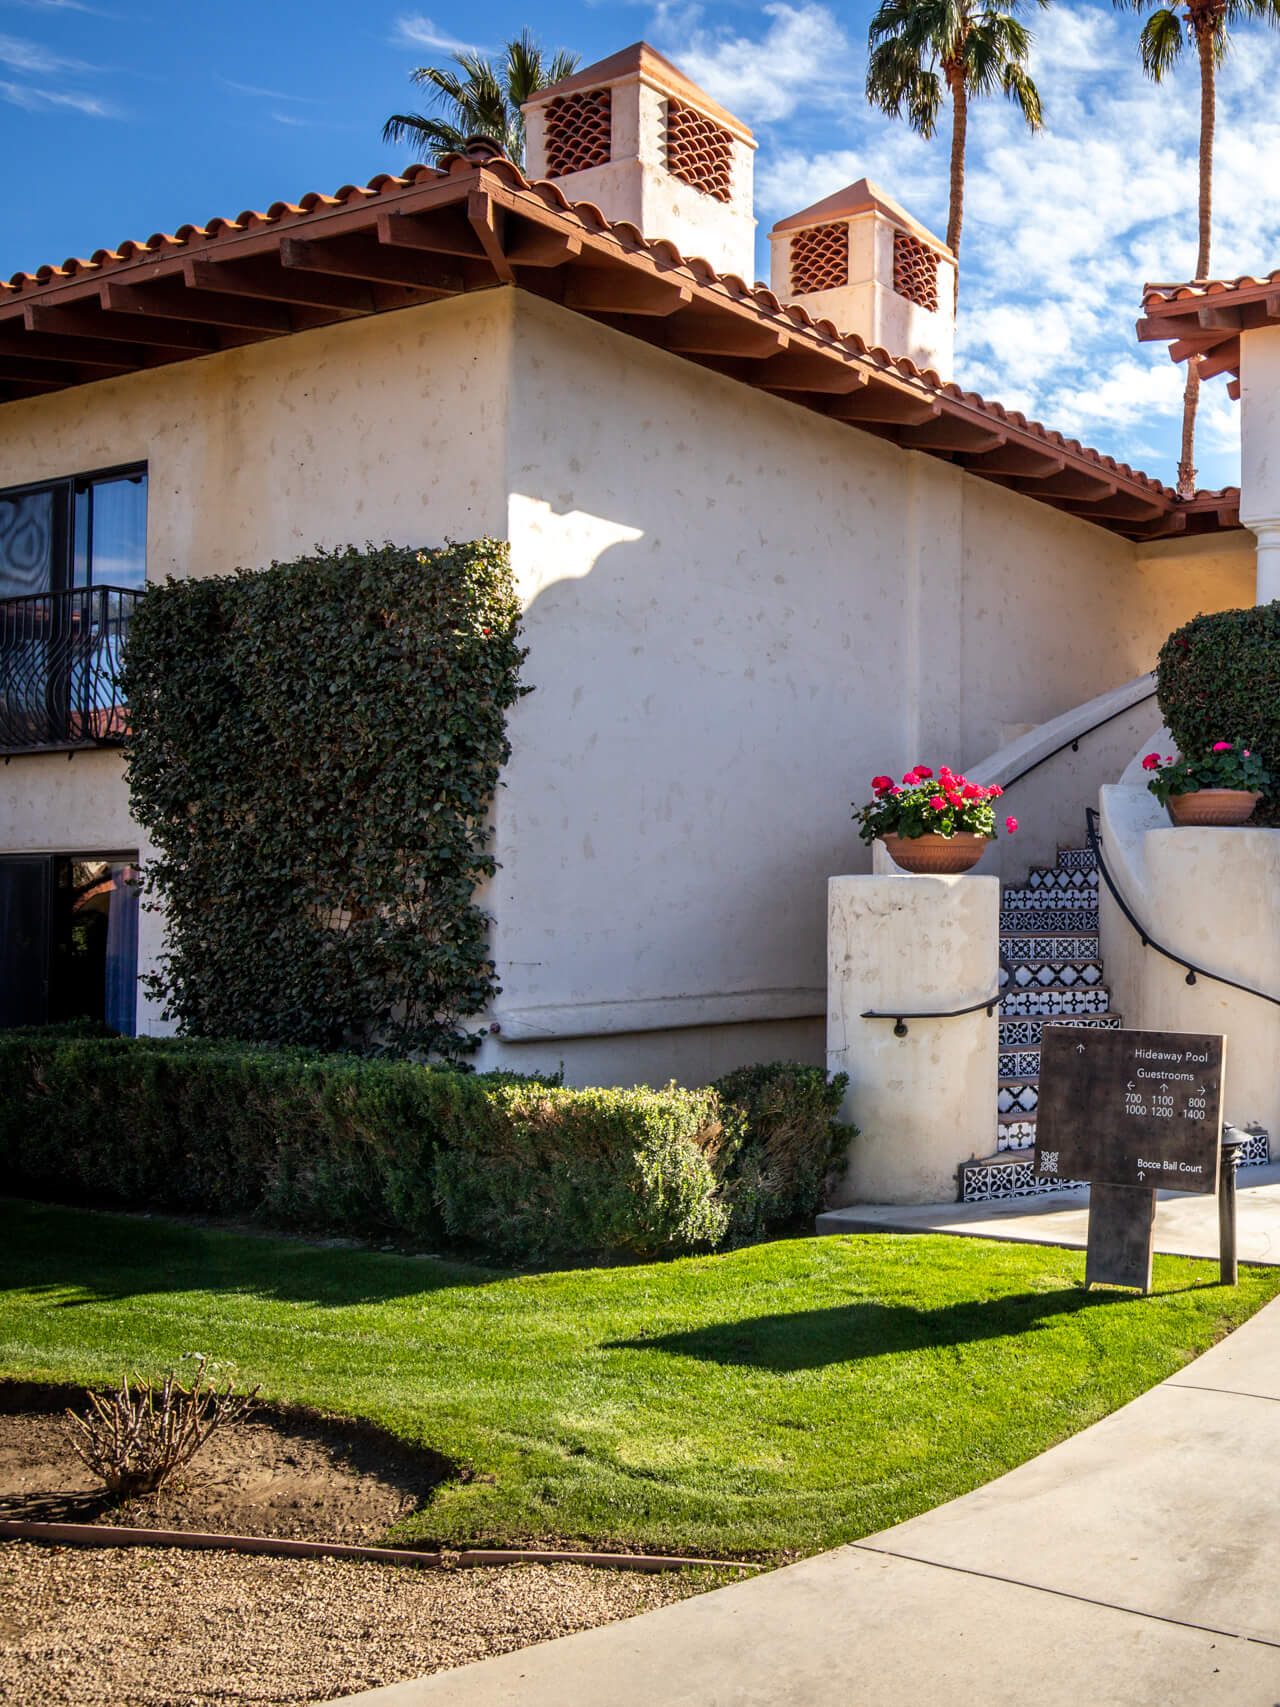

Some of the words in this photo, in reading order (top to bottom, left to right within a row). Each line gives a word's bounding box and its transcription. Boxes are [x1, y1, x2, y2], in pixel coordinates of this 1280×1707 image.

[1135, 1049, 1183, 1063] Hideaway
[1185, 1052, 1208, 1062] Pool
[1136, 1068, 1194, 1081] Guestrooms
[1125, 1093, 1142, 1103] 700
[1151, 1096, 1174, 1106] 1100
[1188, 1098, 1206, 1108] 800
[1125, 1105, 1147, 1115] 1000
[1151, 1107, 1173, 1117] 1200
[1183, 1109, 1205, 1120] 1400
[1137, 1159, 1161, 1169] Bocce
[1163, 1161, 1177, 1170] Ball
[1179, 1162, 1202, 1173] Court
